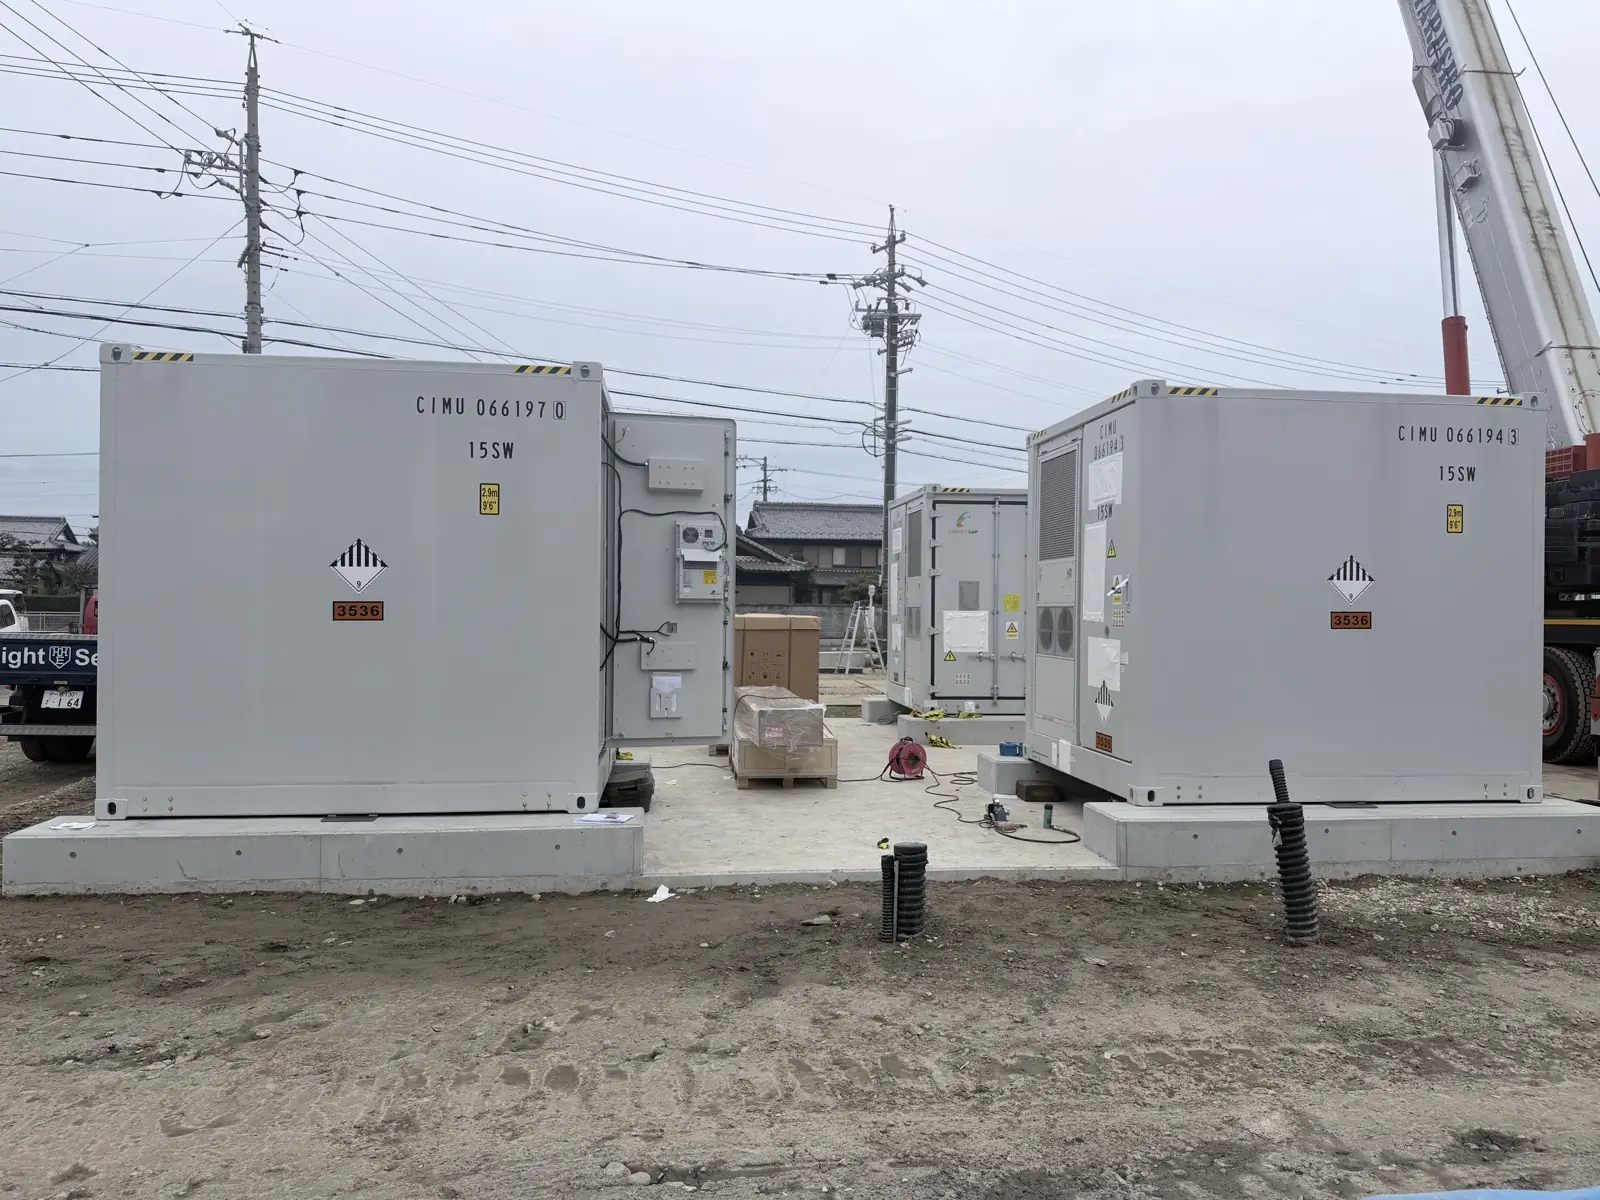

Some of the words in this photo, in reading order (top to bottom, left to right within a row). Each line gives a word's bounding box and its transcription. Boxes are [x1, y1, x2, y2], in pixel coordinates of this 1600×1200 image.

[416, 396, 464, 415] CIMU
[476, 399, 546, 418] 066197
[555, 401, 564, 419] 0
[1398, 426, 1437, 443] CIMU
[1446, 427, 1503, 444] 066194
[1510, 429, 1518, 445] 3
[469, 441, 514, 459] 15SW
[1440, 465, 1476, 482] 15SW
[337, 605, 380, 617] 3536
[1334, 615, 1369, 626] 3536
